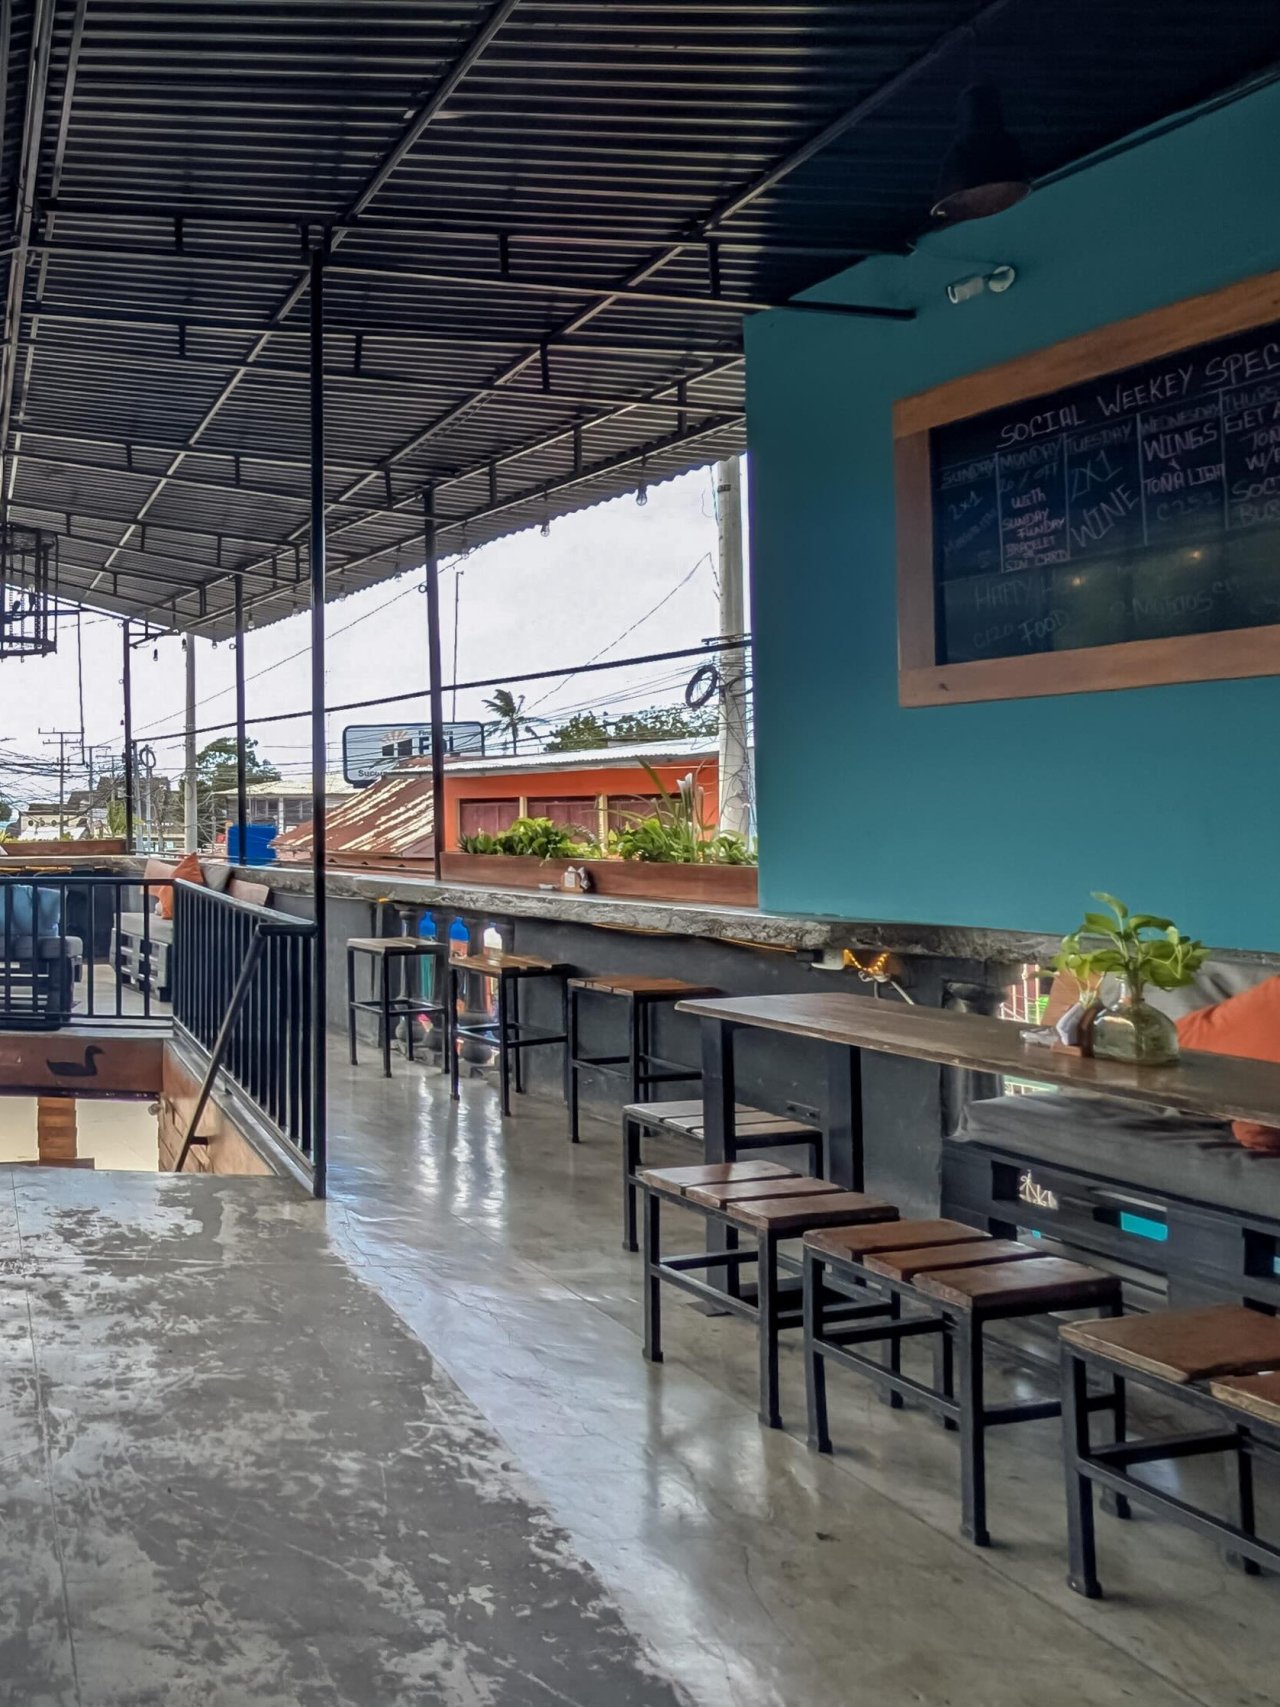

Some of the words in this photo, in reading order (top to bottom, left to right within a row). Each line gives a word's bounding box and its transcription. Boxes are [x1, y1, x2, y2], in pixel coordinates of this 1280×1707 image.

[996, 403, 1085, 448] SOCIAL
[1065, 421, 1132, 453] TUESDAY
[1140, 404, 1220, 435] WEDNESDAY
[1223, 406, 1267, 434] GET
[1143, 422, 1218, 462] WINGS
[1070, 482, 1140, 547] WINE
